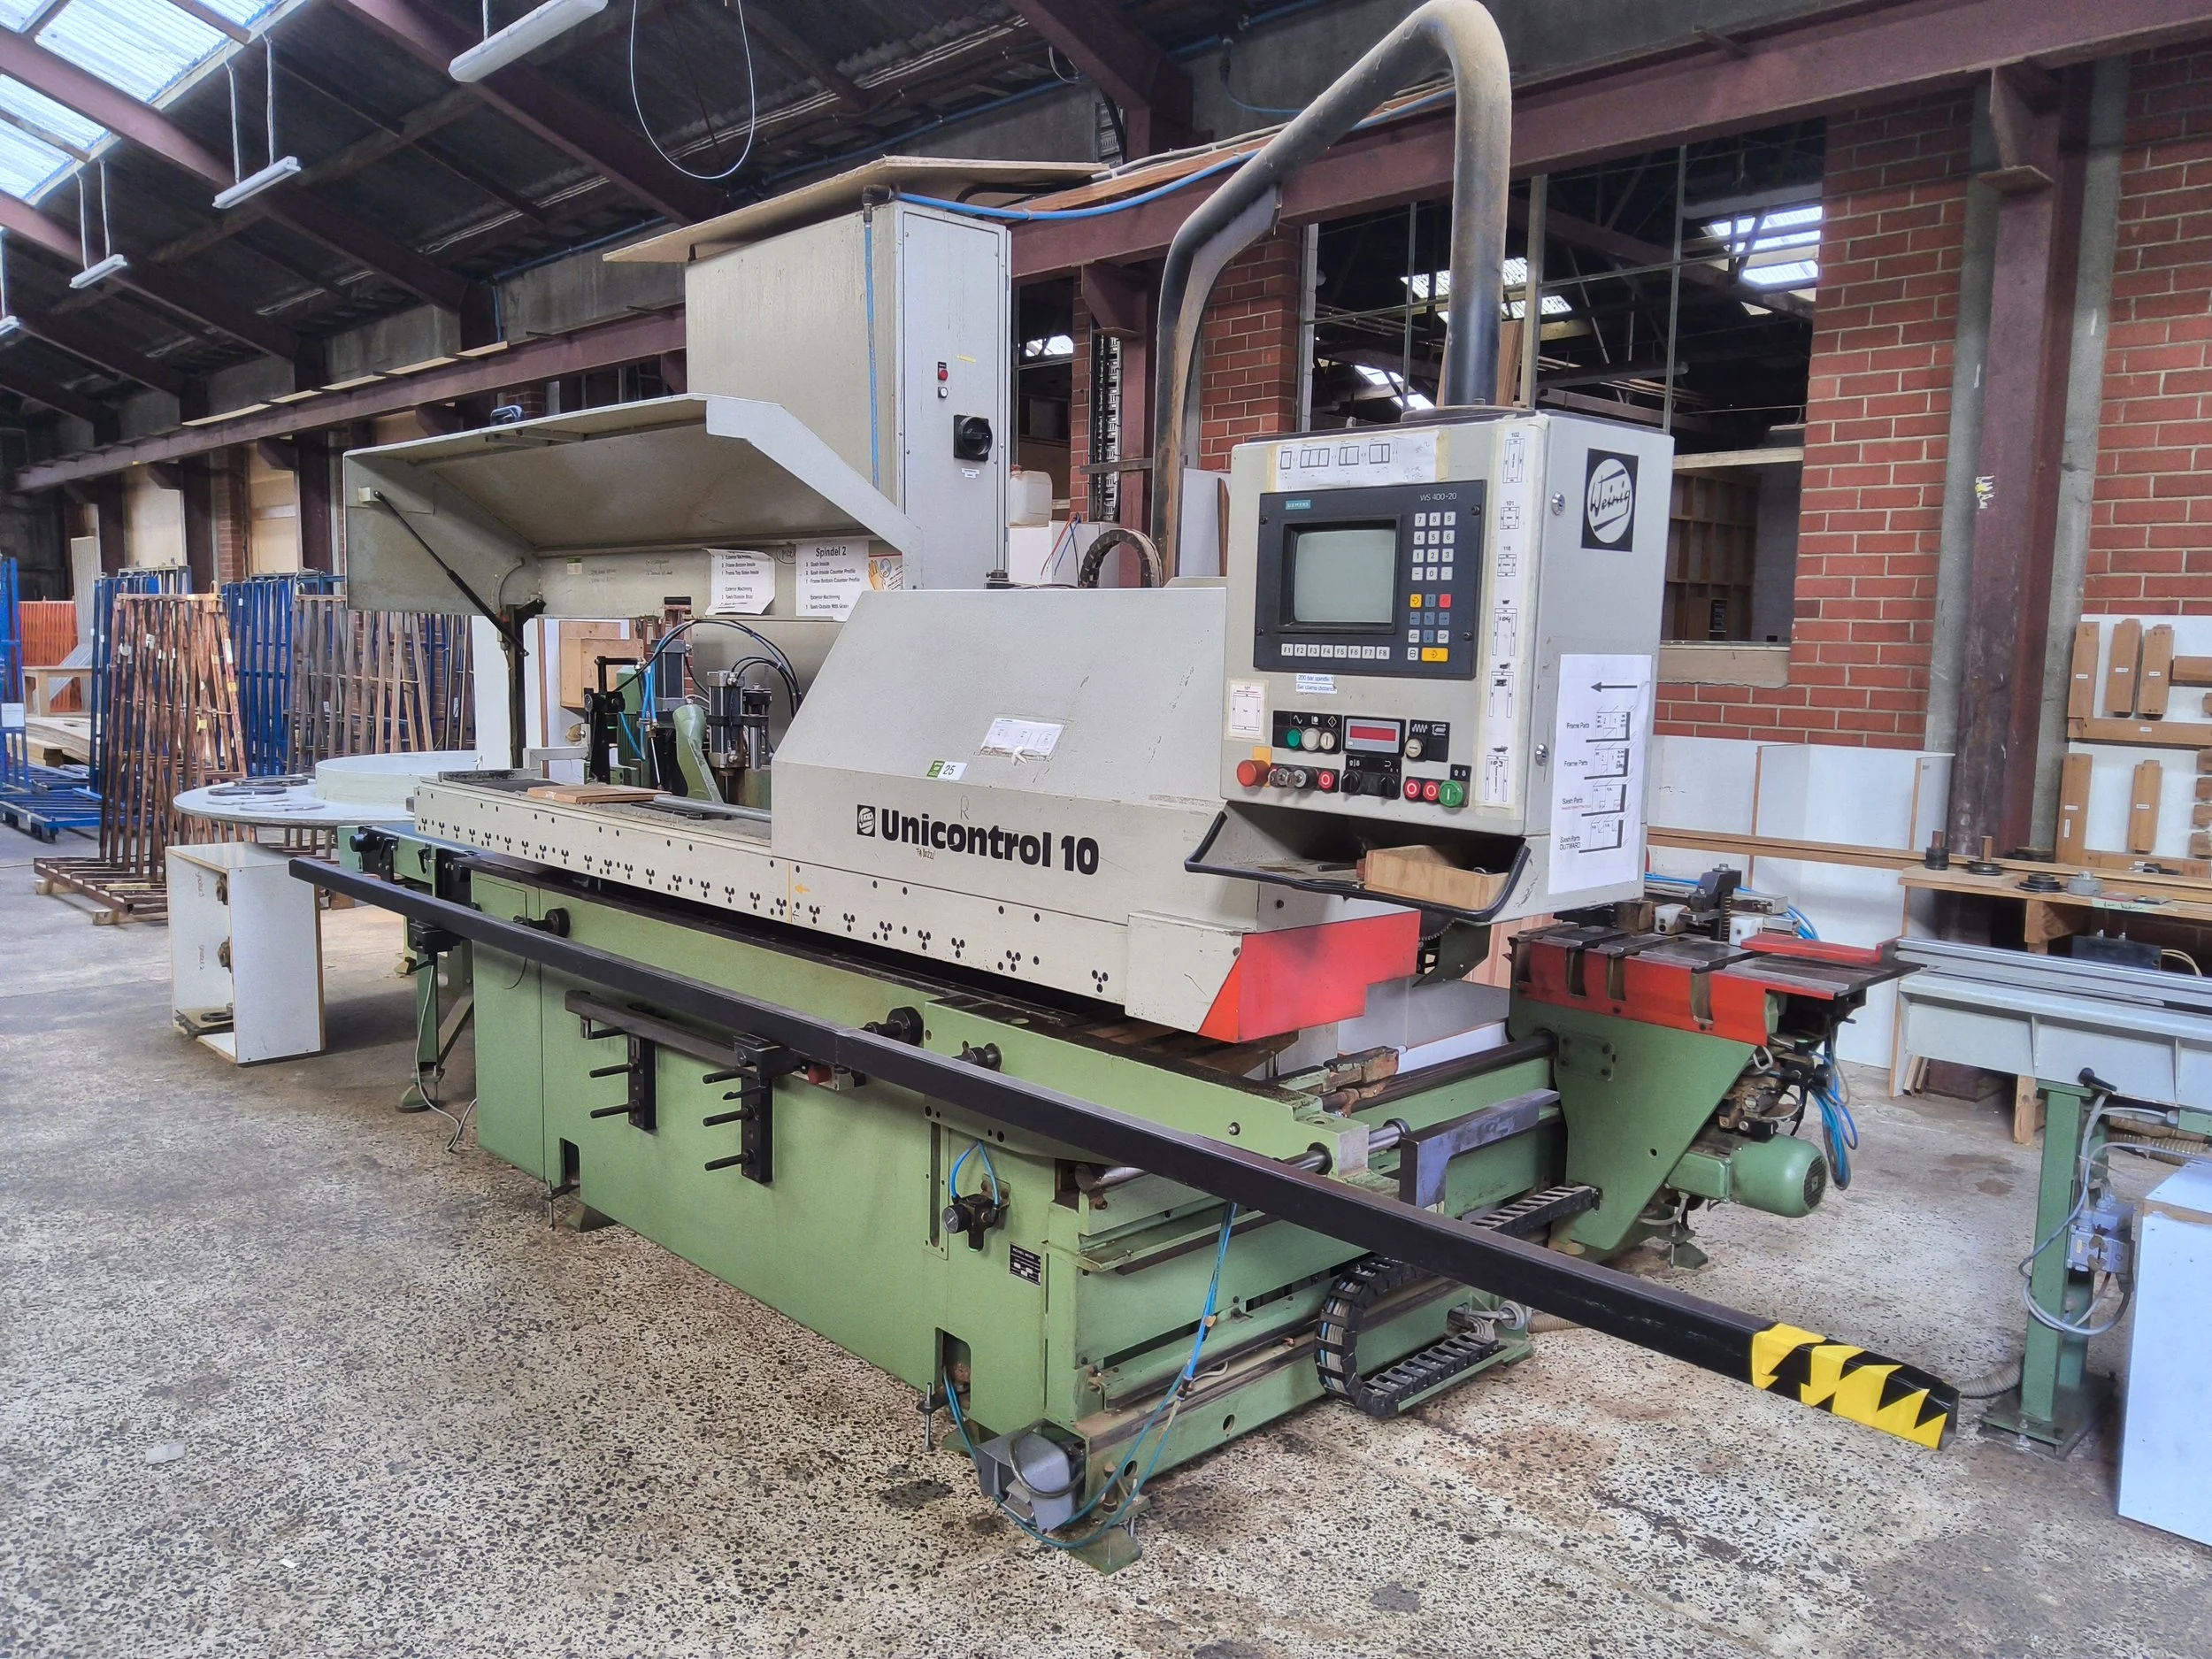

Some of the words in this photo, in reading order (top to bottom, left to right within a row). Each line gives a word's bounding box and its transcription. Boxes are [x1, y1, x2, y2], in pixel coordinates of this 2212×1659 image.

[1432, 492, 1457, 501] 400-20
[815, 547, 841, 558] Spindel
[841, 546, 847, 556] 2
[942, 764, 956, 776] 25
[881, 808, 1052, 868] Unicontrol
[1061, 835, 1100, 876] 10
[1559, 841, 1581, 850] OUTWARD
